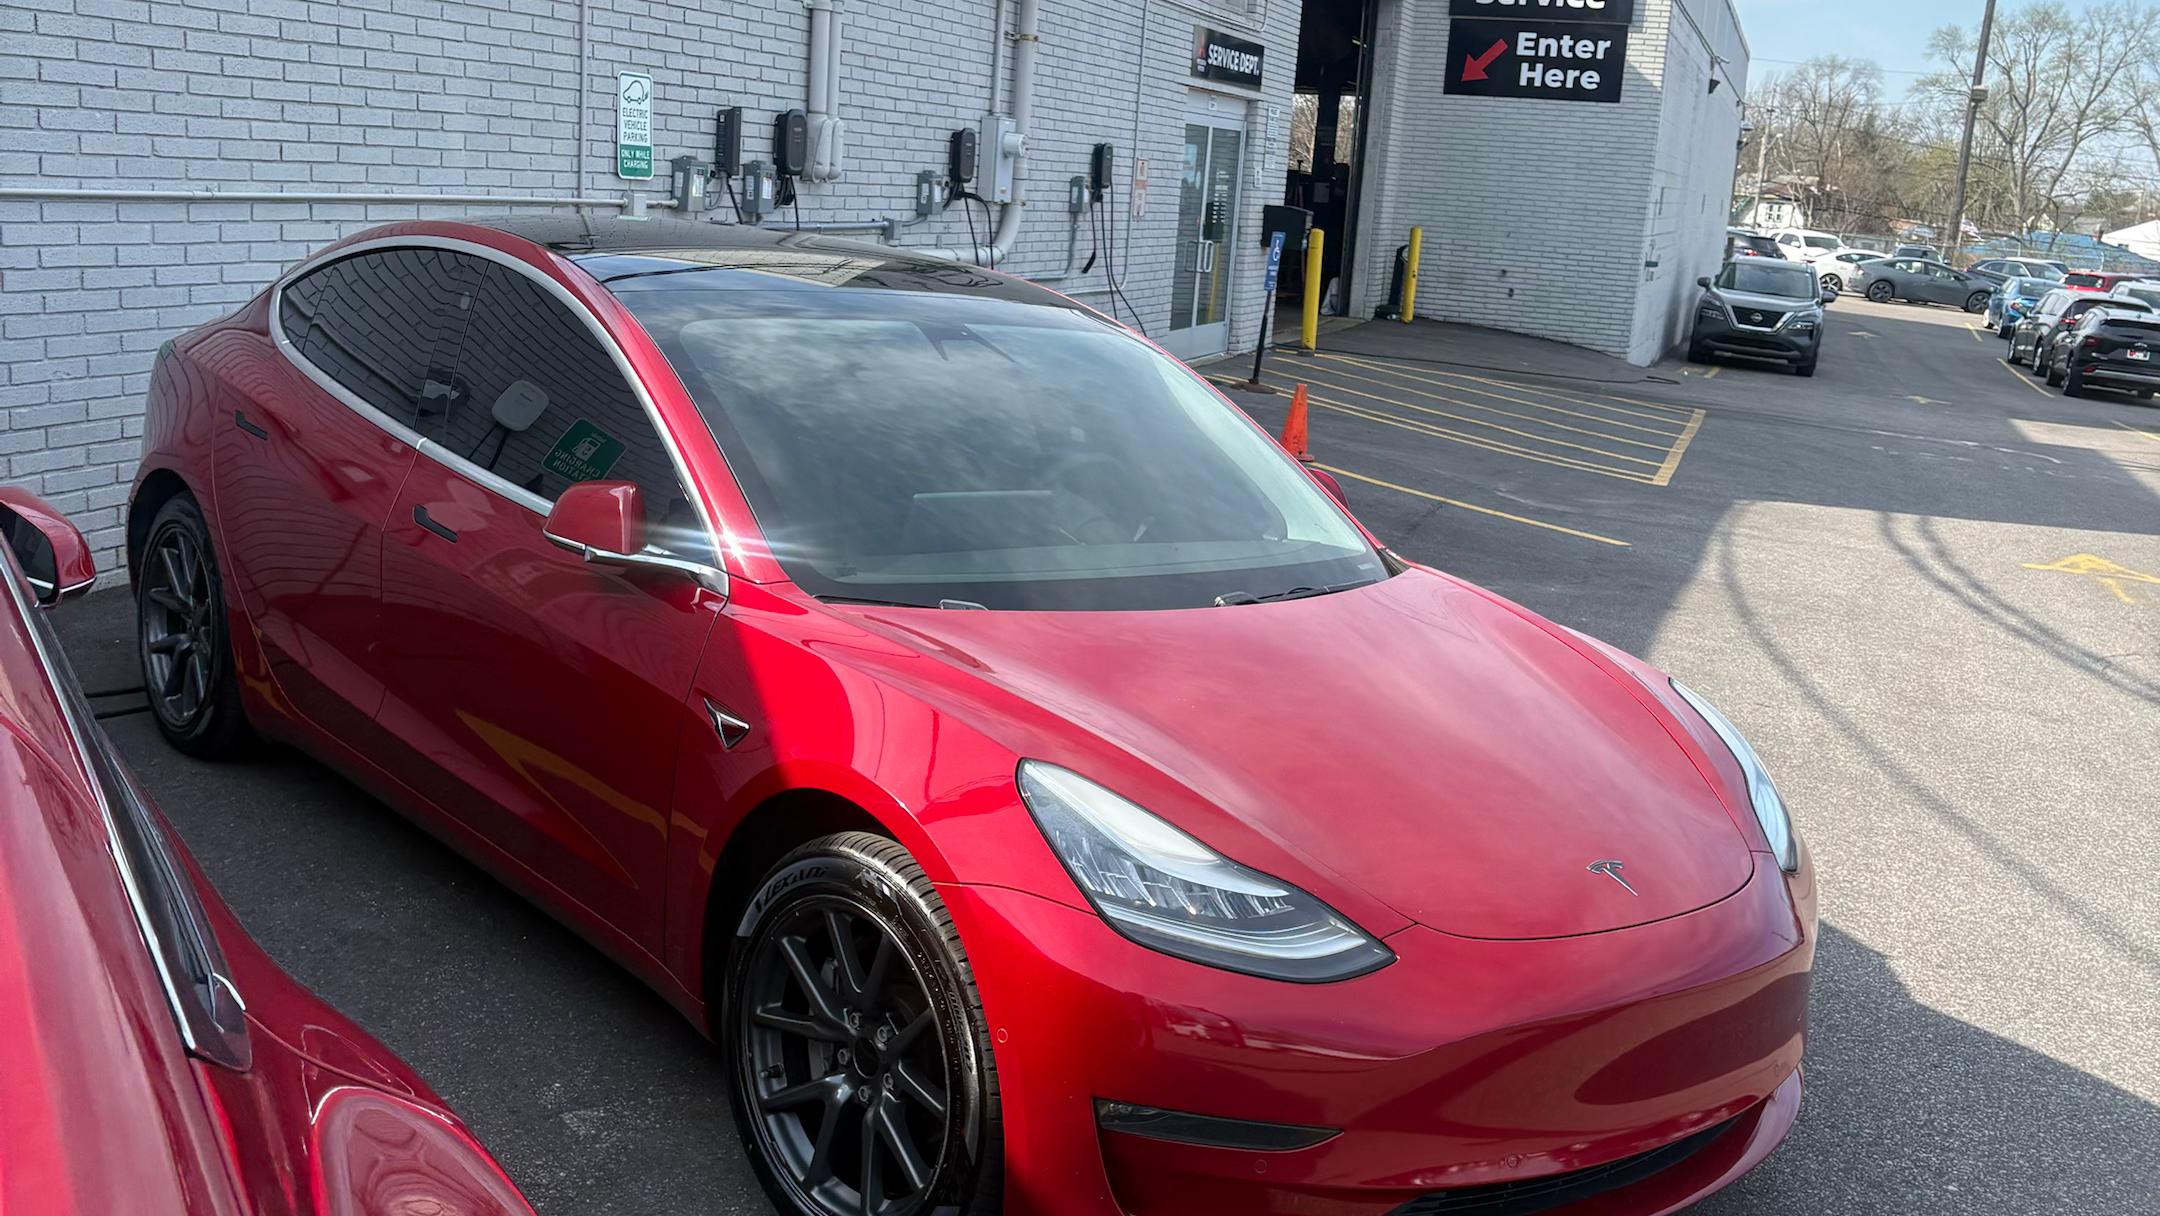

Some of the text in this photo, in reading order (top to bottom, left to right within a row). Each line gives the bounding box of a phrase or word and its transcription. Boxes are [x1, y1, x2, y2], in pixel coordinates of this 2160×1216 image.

[1515, 31, 1612, 60] Enter
[1207, 43, 1240, 71] SERVICE
[1239, 52, 1260, 76] DEPT.
[1518, 62, 1601, 90] Here
[622, 107, 648, 119] ELECTRIC
[623, 120, 647, 131] VEHICLE
[623, 131, 648, 143] PARKING
[621, 149, 650, 160] ONLY WHILE
[623, 159, 648, 169] CHARGING
